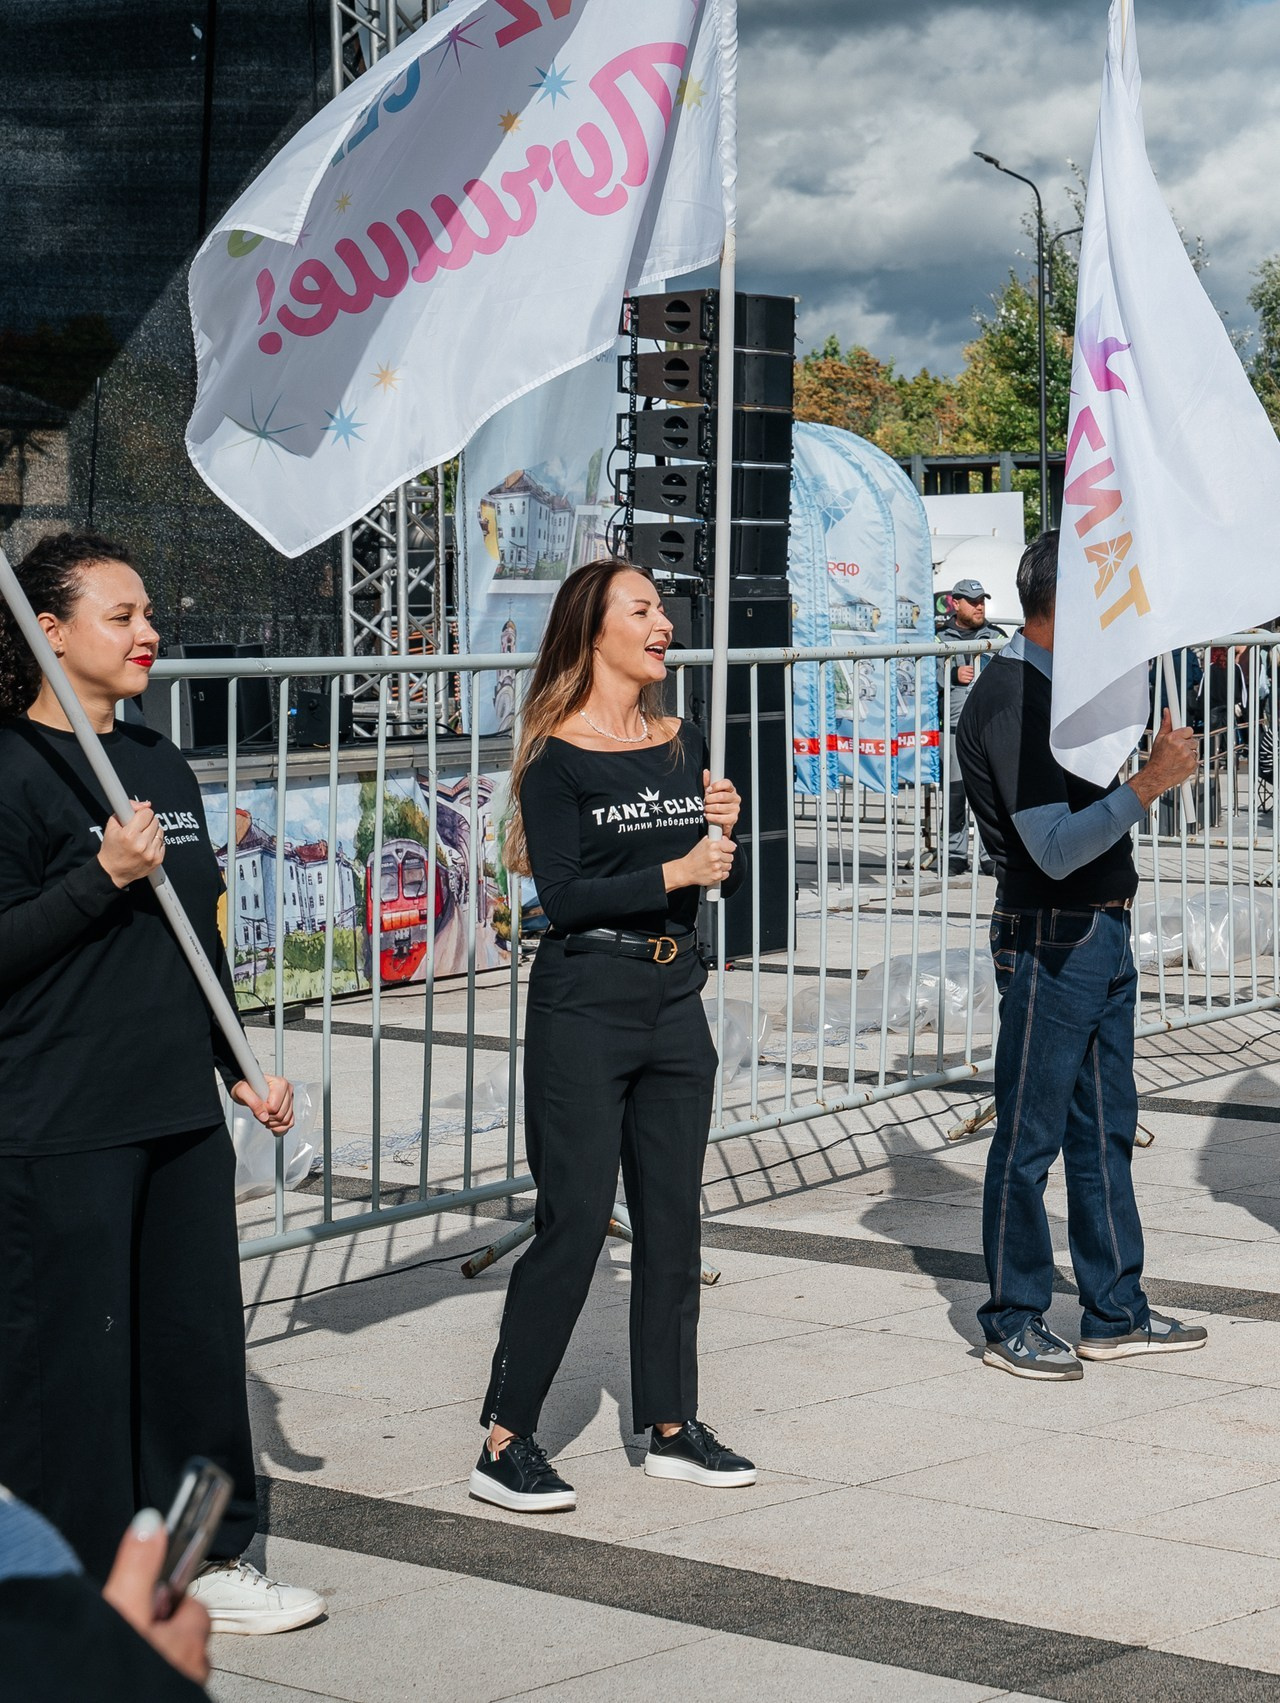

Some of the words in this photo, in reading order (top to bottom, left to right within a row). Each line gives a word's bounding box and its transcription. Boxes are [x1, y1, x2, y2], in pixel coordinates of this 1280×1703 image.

[592, 802, 650, 826] TANZ
[663, 796, 704, 815] CLAS
[154, 811, 200, 832] CLASS
[617, 821, 653, 834] Лилии
[655, 815, 704, 828] Лебедевой
[163, 832, 200, 846] бедевой
